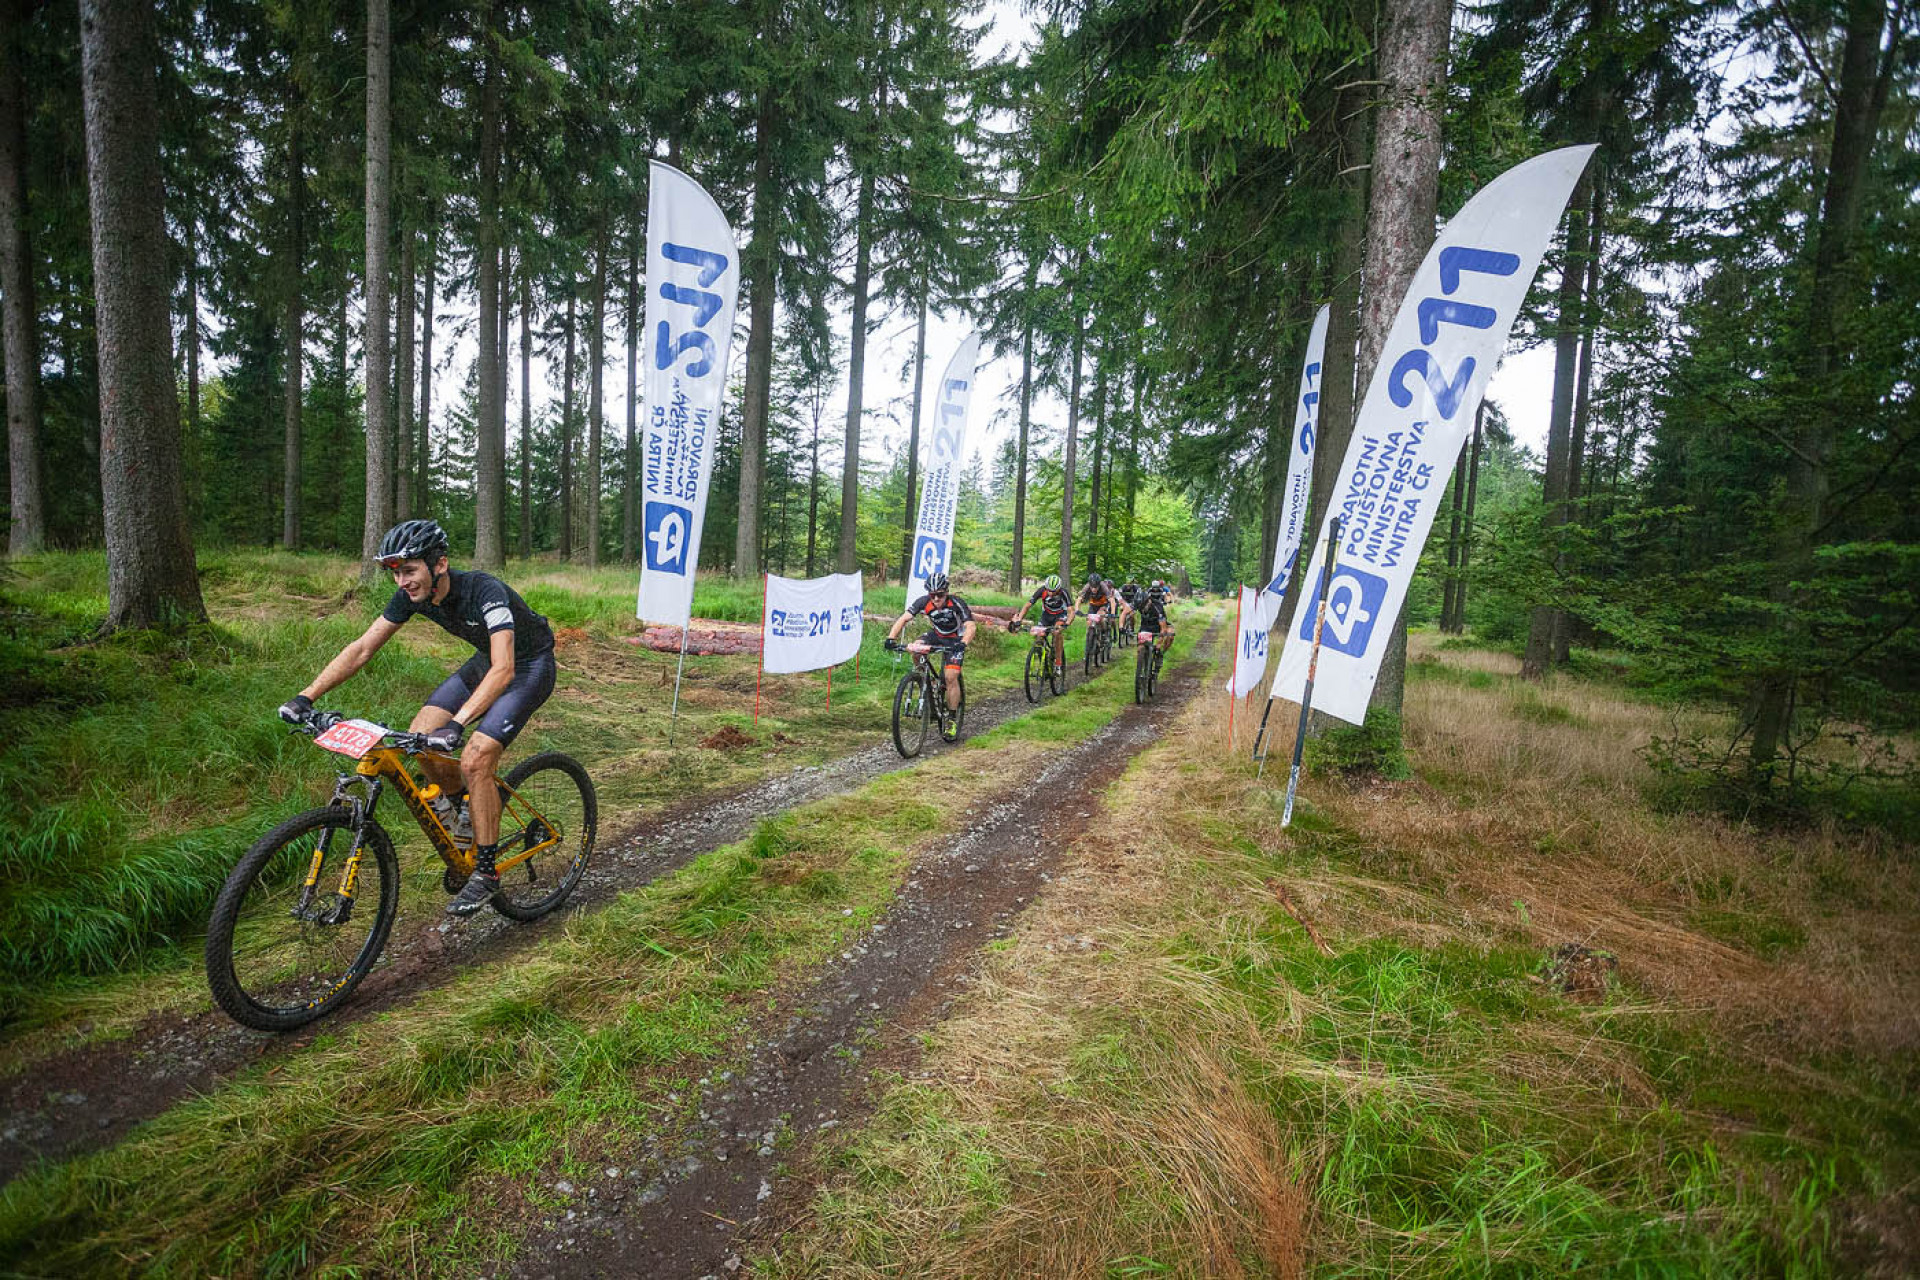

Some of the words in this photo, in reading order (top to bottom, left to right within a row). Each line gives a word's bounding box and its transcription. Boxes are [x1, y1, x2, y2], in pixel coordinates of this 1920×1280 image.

[1388, 246, 1521, 421] 211
[934, 378, 968, 460] 211
[1337, 435, 1380, 541] DRAVOTNÍ
[1346, 431, 1404, 557] POJIŠŤOVNA
[1362, 420, 1430, 564] MINISTERSTVA
[1381, 498, 1421, 569] VNITRA
[1406, 462, 1435, 492] ČR
[333, 726, 372, 748] 4178
